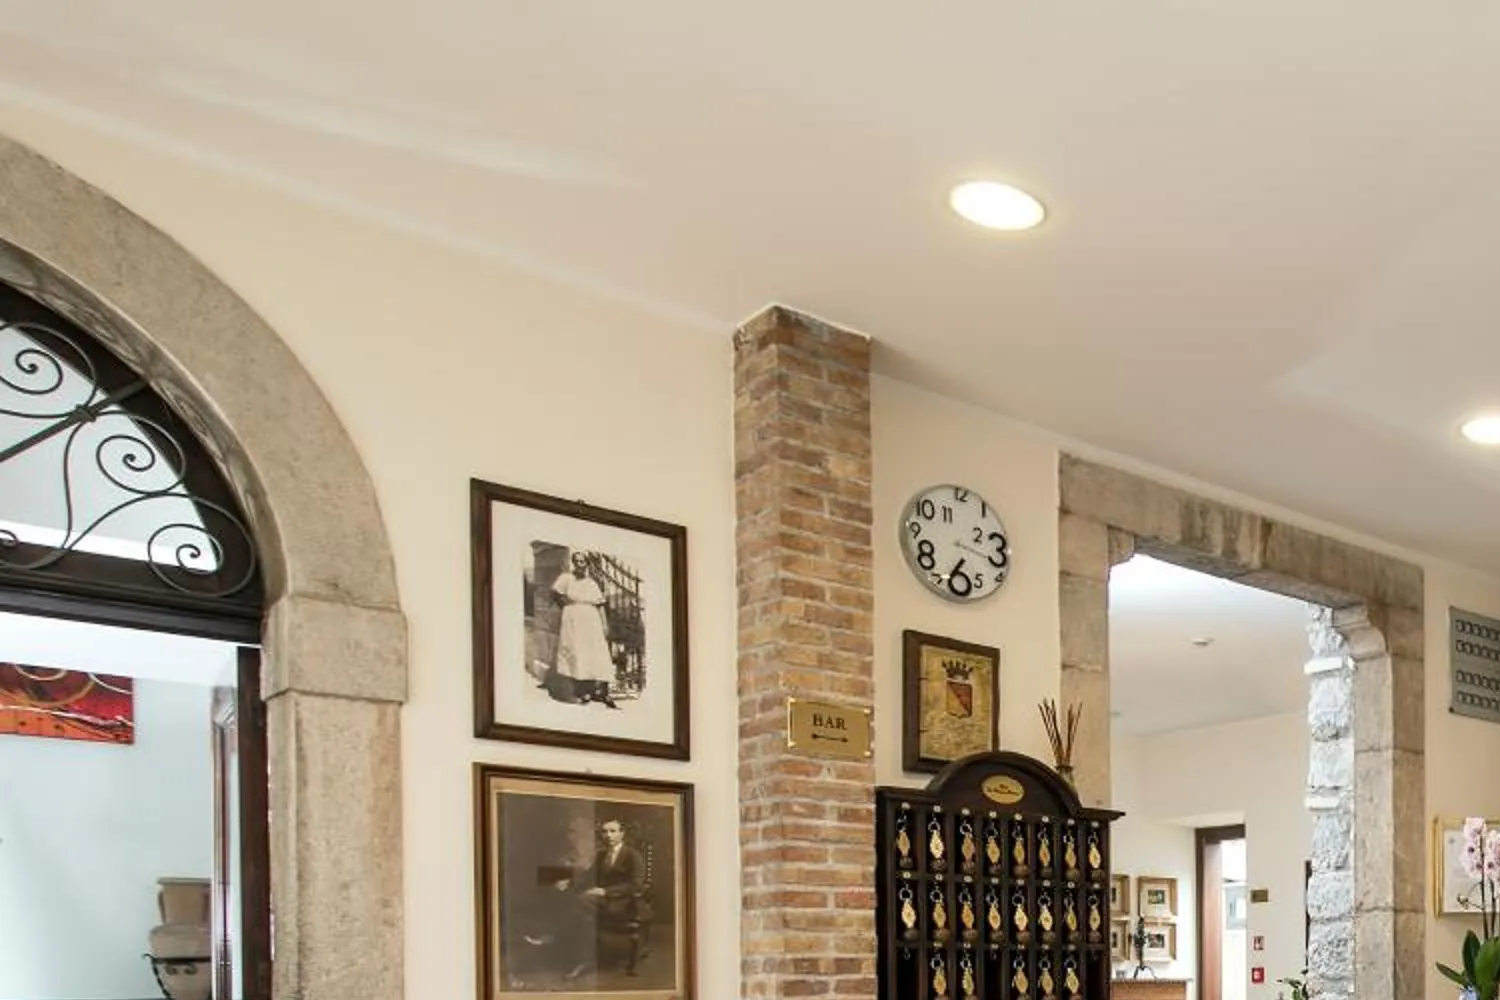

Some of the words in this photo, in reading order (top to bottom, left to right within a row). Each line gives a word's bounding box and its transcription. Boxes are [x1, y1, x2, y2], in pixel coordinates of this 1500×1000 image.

[954, 486, 969, 503] 12
[916, 498, 935, 521] 10
[942, 505, 953, 524] 11
[981, 501, 987, 519] 1
[910, 521, 922, 540] 9
[972, 527, 983, 544] 2
[917, 539, 935, 571] 8
[987, 531, 1007, 568] 3
[947, 557, 973, 597] 6
[973, 573, 984, 589] 5
[813, 712, 848, 731] BAR
